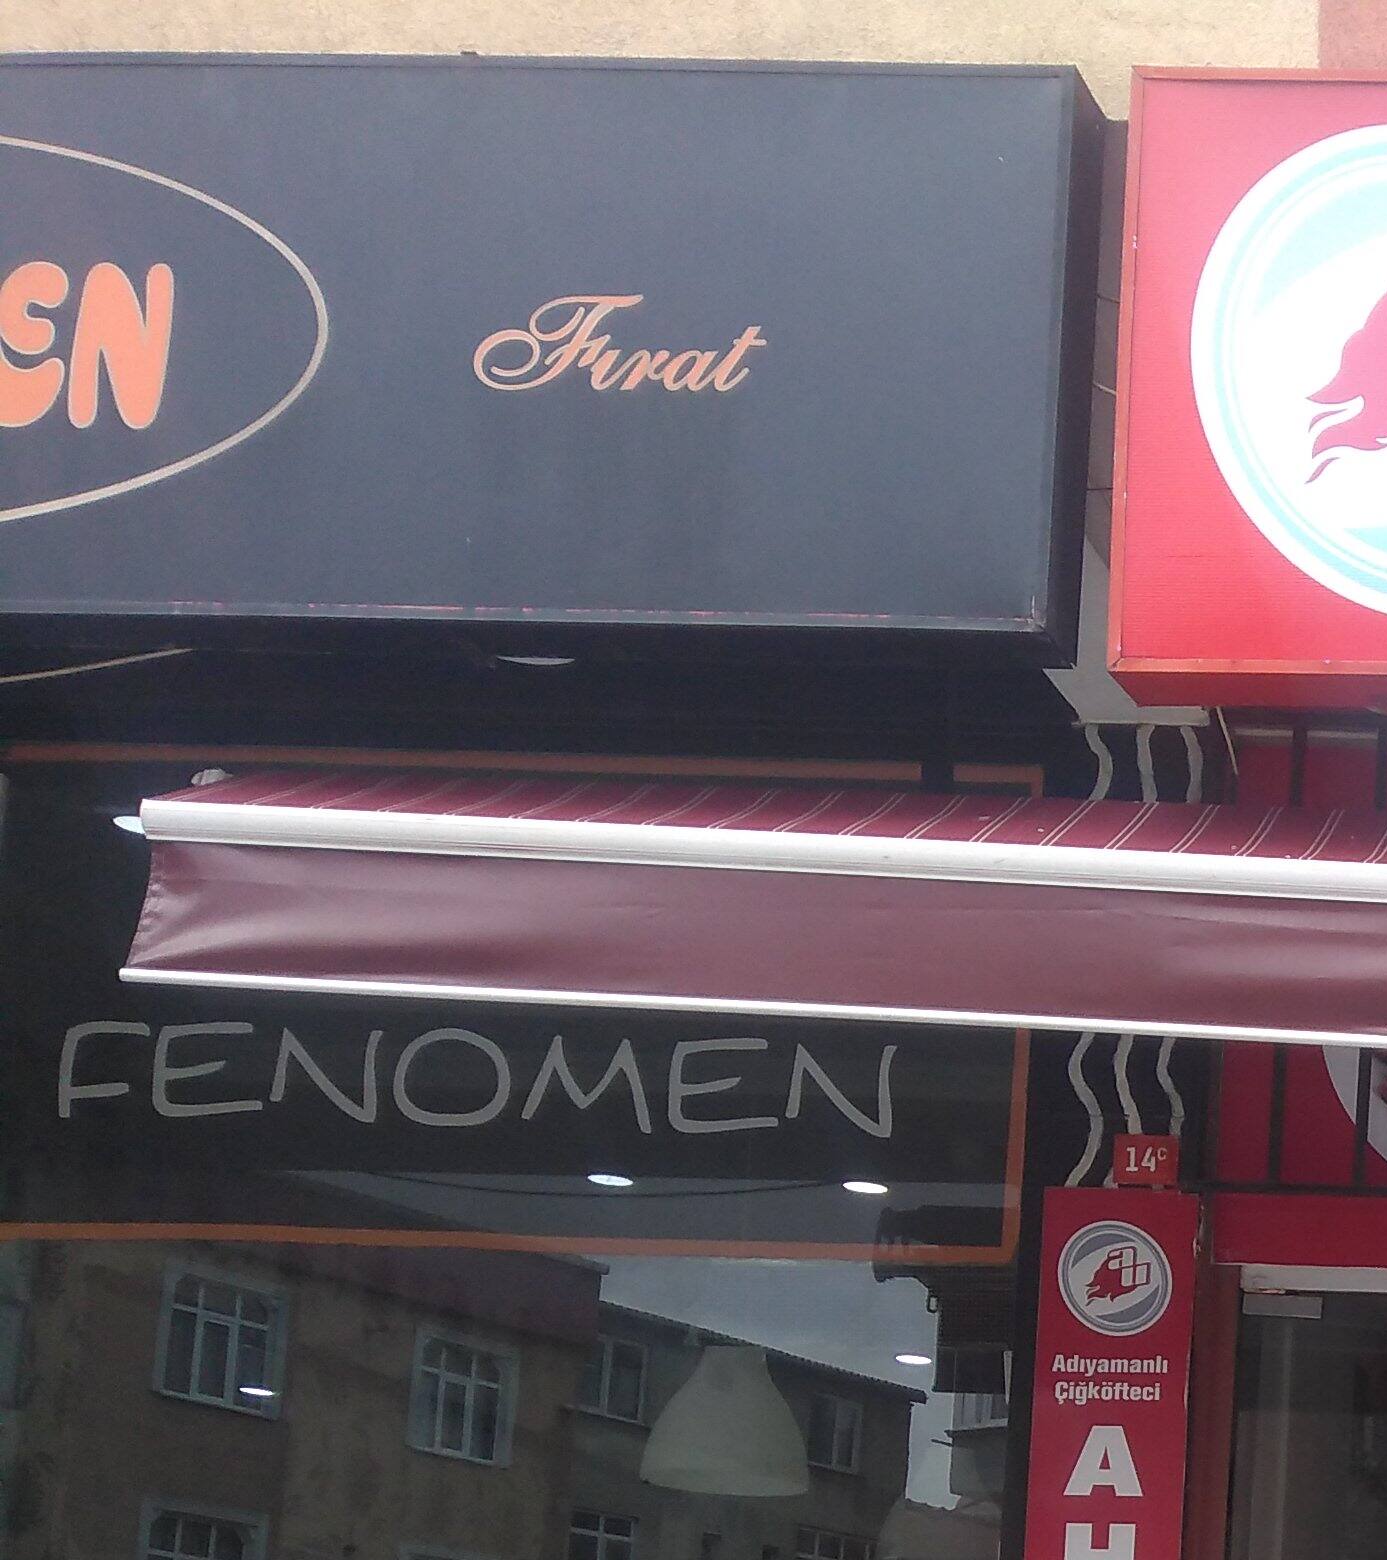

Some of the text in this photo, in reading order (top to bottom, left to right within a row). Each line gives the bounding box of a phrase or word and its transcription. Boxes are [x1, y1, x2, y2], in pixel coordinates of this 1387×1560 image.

[57, 1020, 898, 1139] FENOMEN
[1051, 1353, 1168, 1376] Adıyamanlı
[1054, 1380, 1161, 1405] Çiğköfteci
